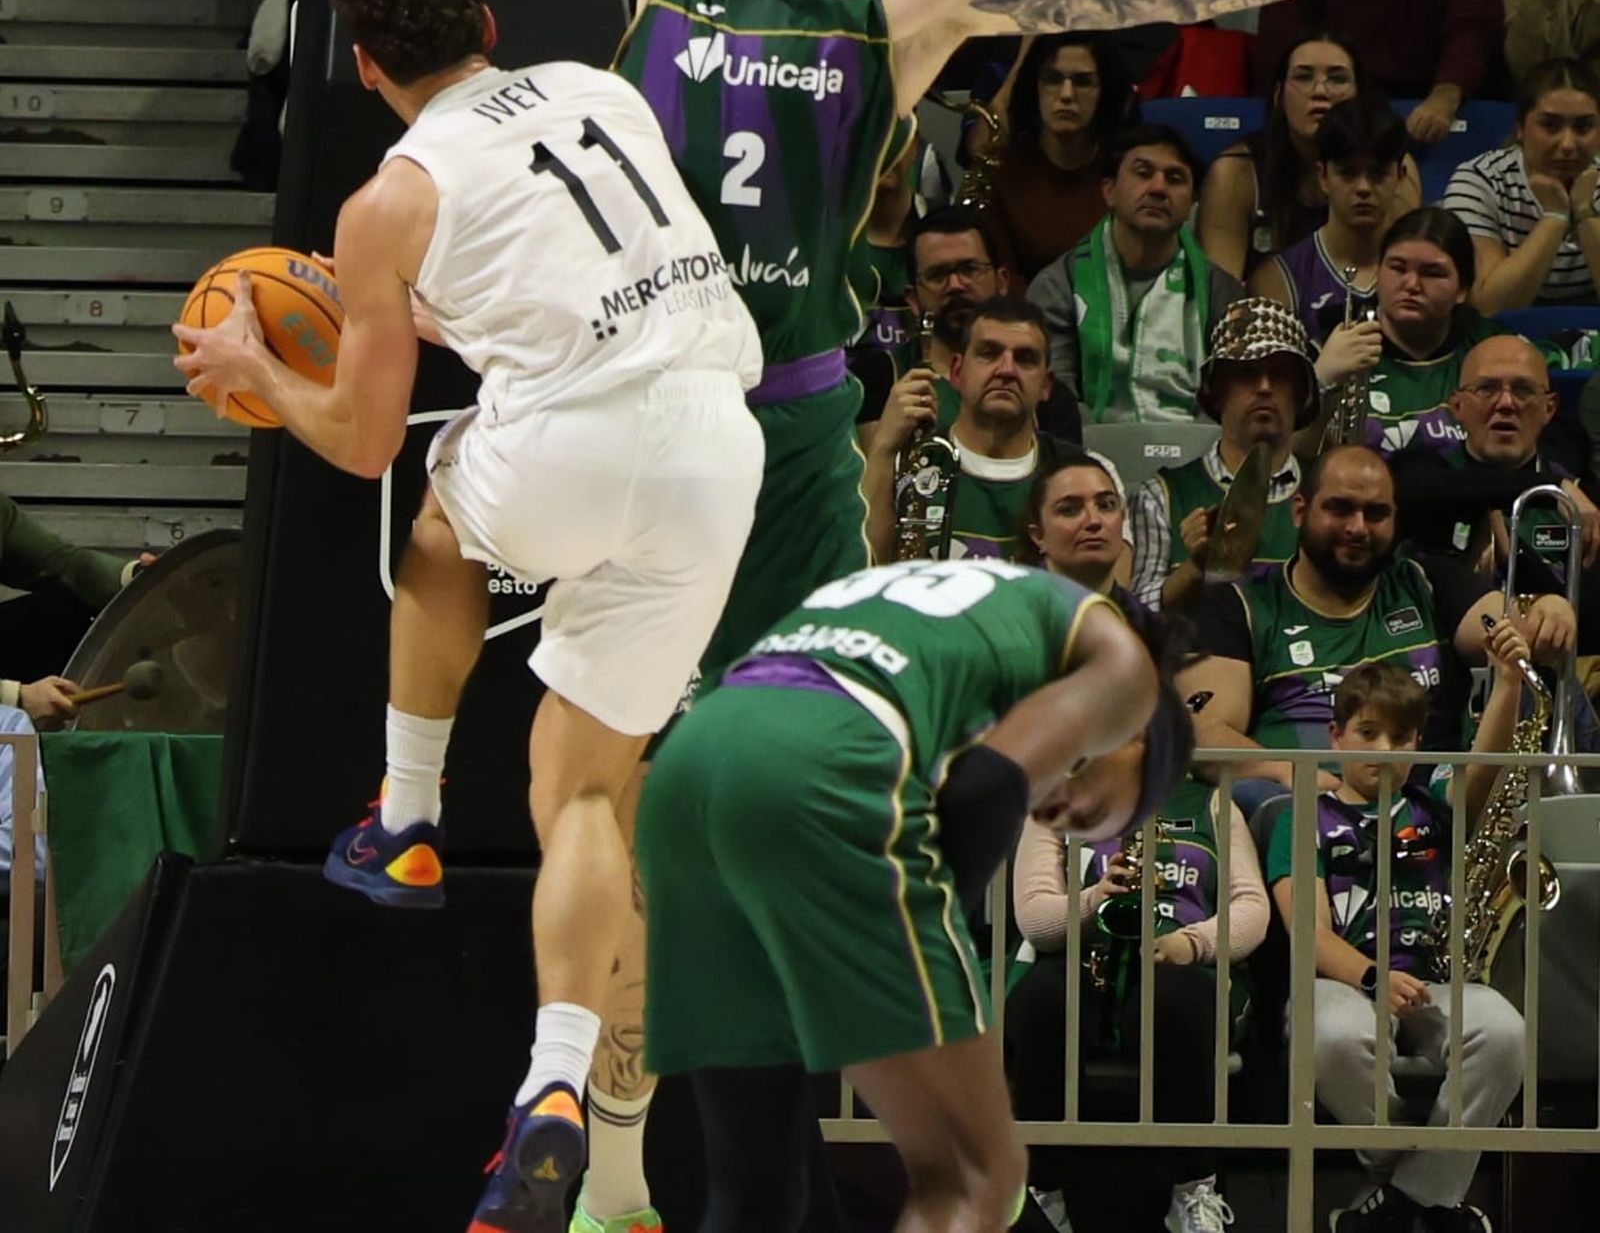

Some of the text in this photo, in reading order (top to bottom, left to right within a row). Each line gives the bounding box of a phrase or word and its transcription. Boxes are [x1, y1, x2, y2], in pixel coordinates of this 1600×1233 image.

[722, 52, 844, 101] Unicaja
[11, 95, 42, 112] 10
[473, 77, 549, 124] IVEY
[528, 116, 671, 255] 11
[720, 131, 766, 207] 2
[49, 196, 64, 214] 9
[600, 251, 729, 320] MERCATOR
[727, 243, 810, 287] alucía
[89, 300, 102, 317] 8
[125, 409, 139, 426] 7
[170, 523, 184, 540] 6
